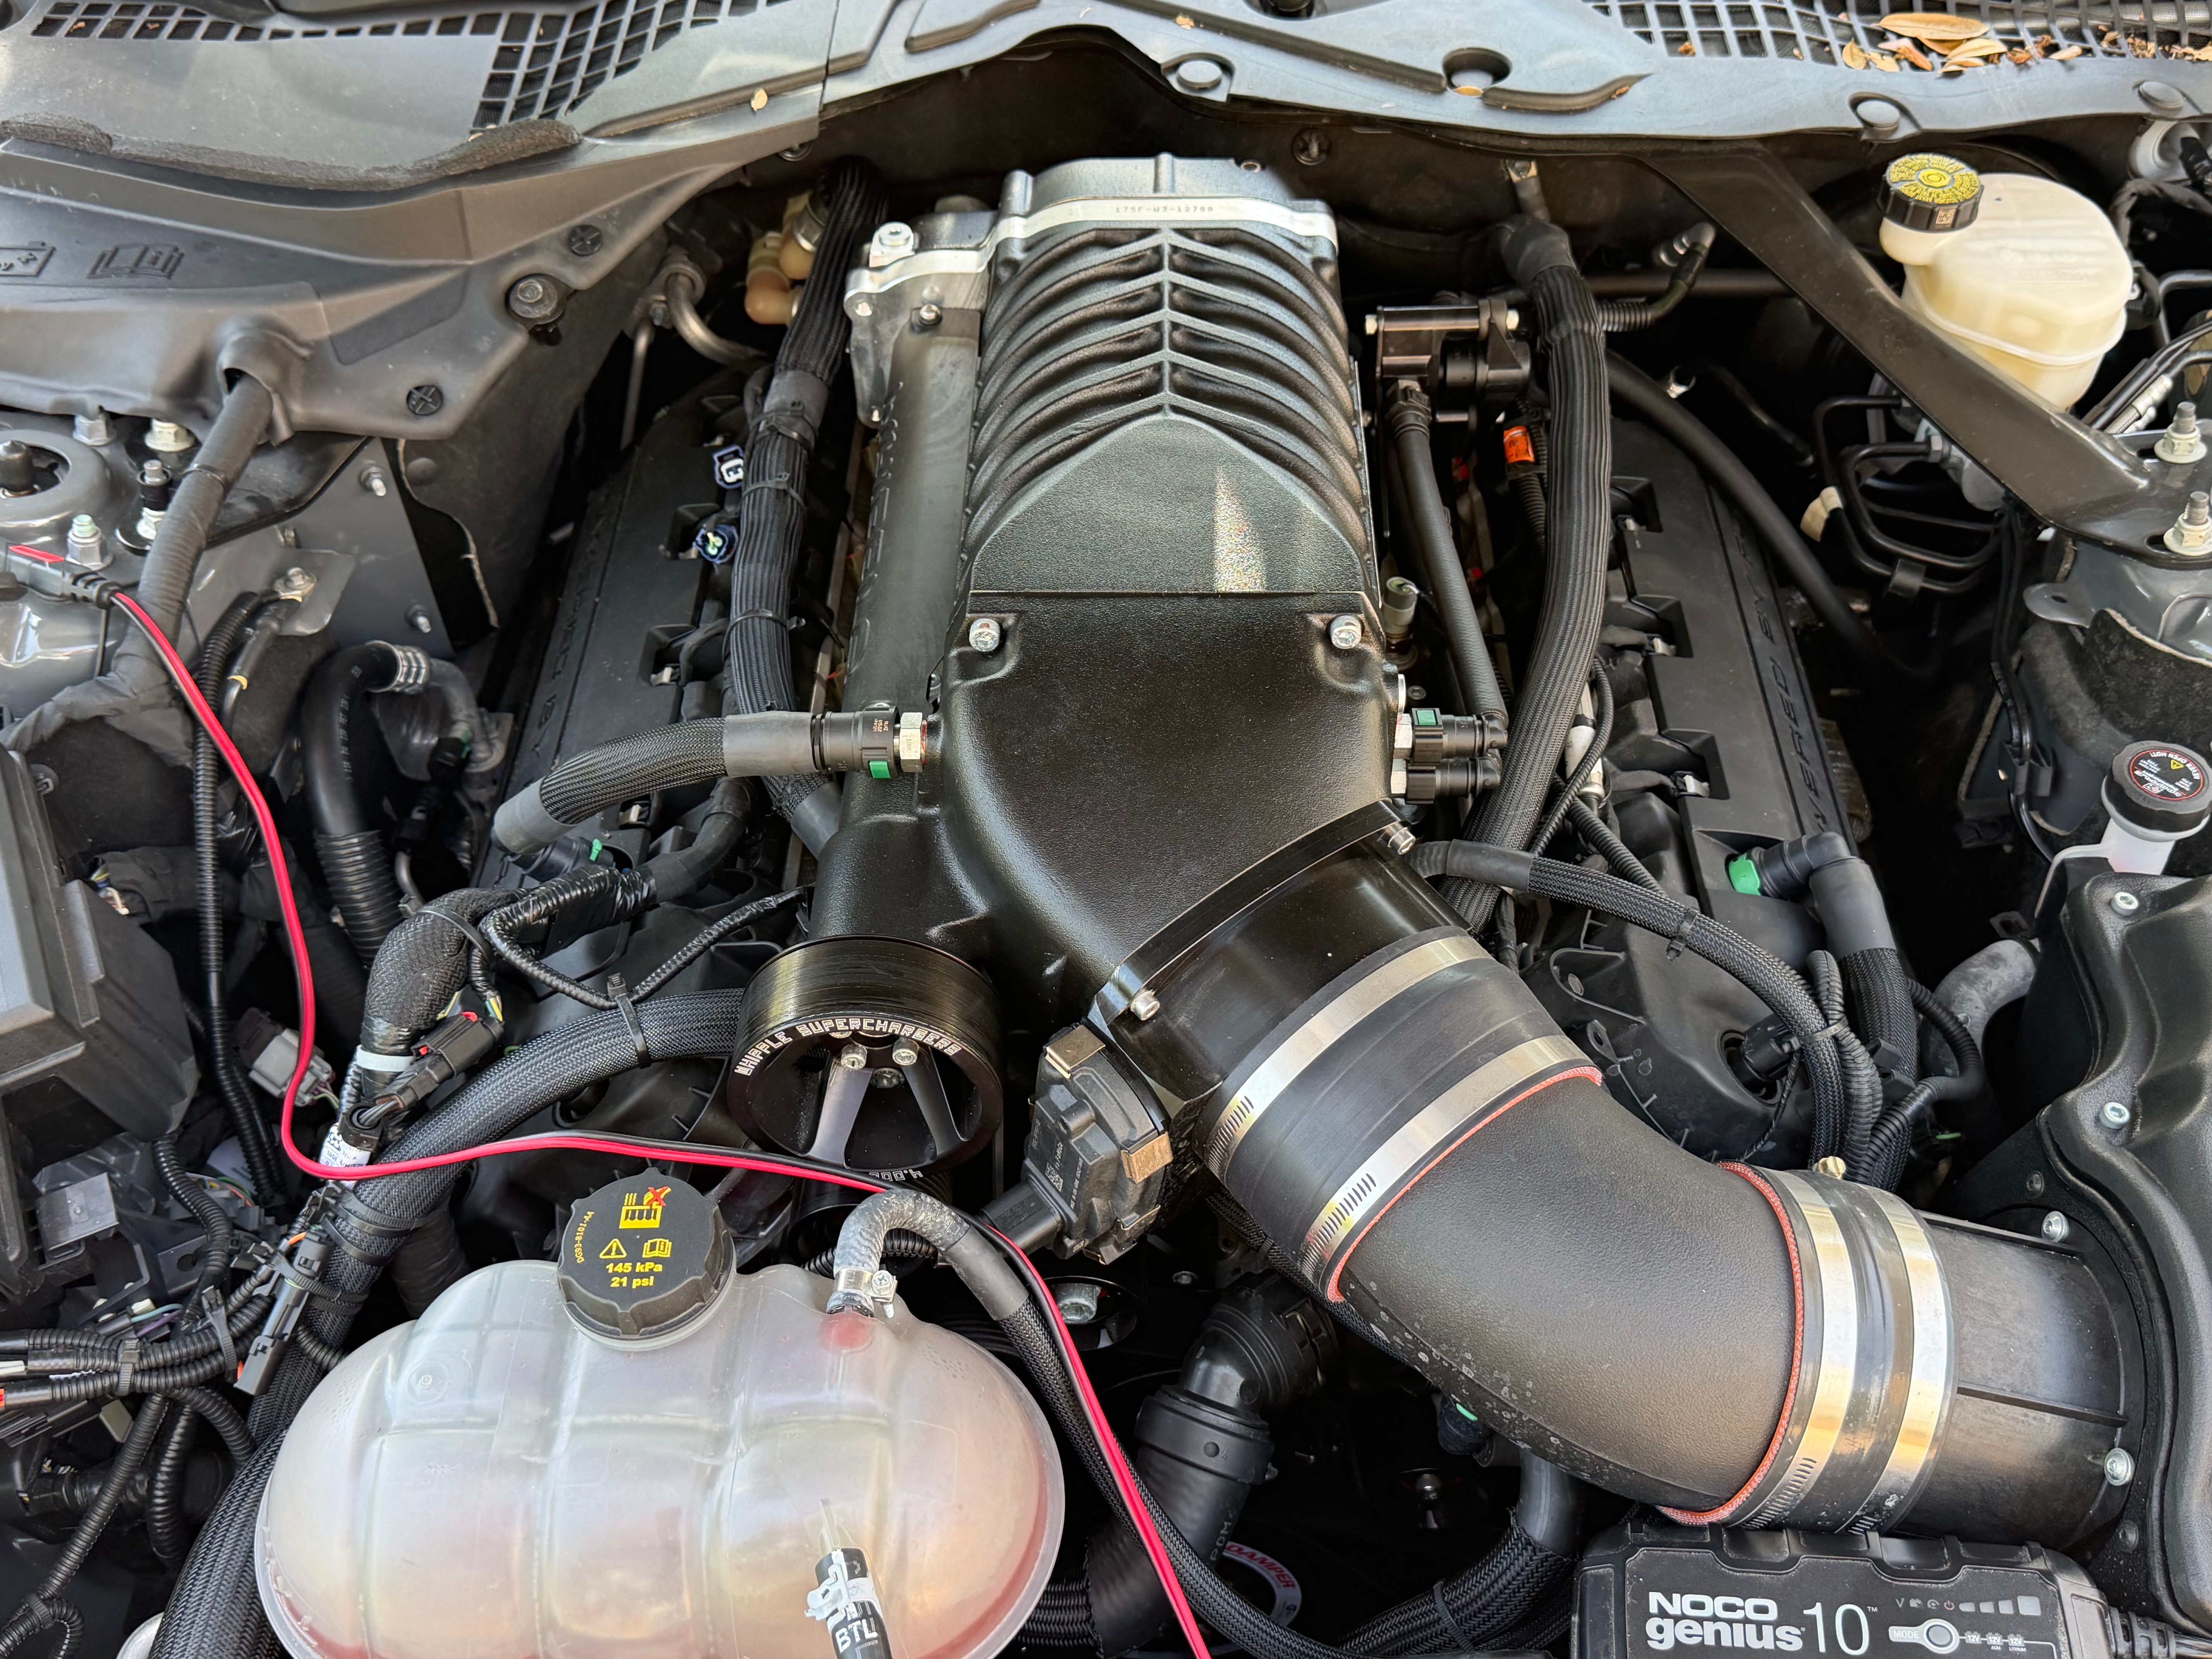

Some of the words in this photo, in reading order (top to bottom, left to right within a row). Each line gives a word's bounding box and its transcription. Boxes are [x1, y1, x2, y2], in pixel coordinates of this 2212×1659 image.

[2168, 753, 2188, 764] OPEN
[734, 1031, 793, 1076] WHIPPLE
[799, 1018, 962, 1057] SUPERCHARGERS
[576, 1211, 595, 1264] DG93-8101-AA
[606, 1262, 632, 1273] 145
[635, 1262, 663, 1273] kPa
[610, 1277, 627, 1288] 21
[632, 1277, 654, 1289] psi
[1226, 1544, 1296, 1589] DAMPER
[1649, 1591, 1778, 1621] NOCO
[835, 1619, 878, 1653] BTL
[1645, 1616, 1803, 1651] genius
[1803, 1602, 1870, 1656] 10
[1893, 1630, 1920, 1639] MODE
[1967, 1634, 1980, 1642] 12V
